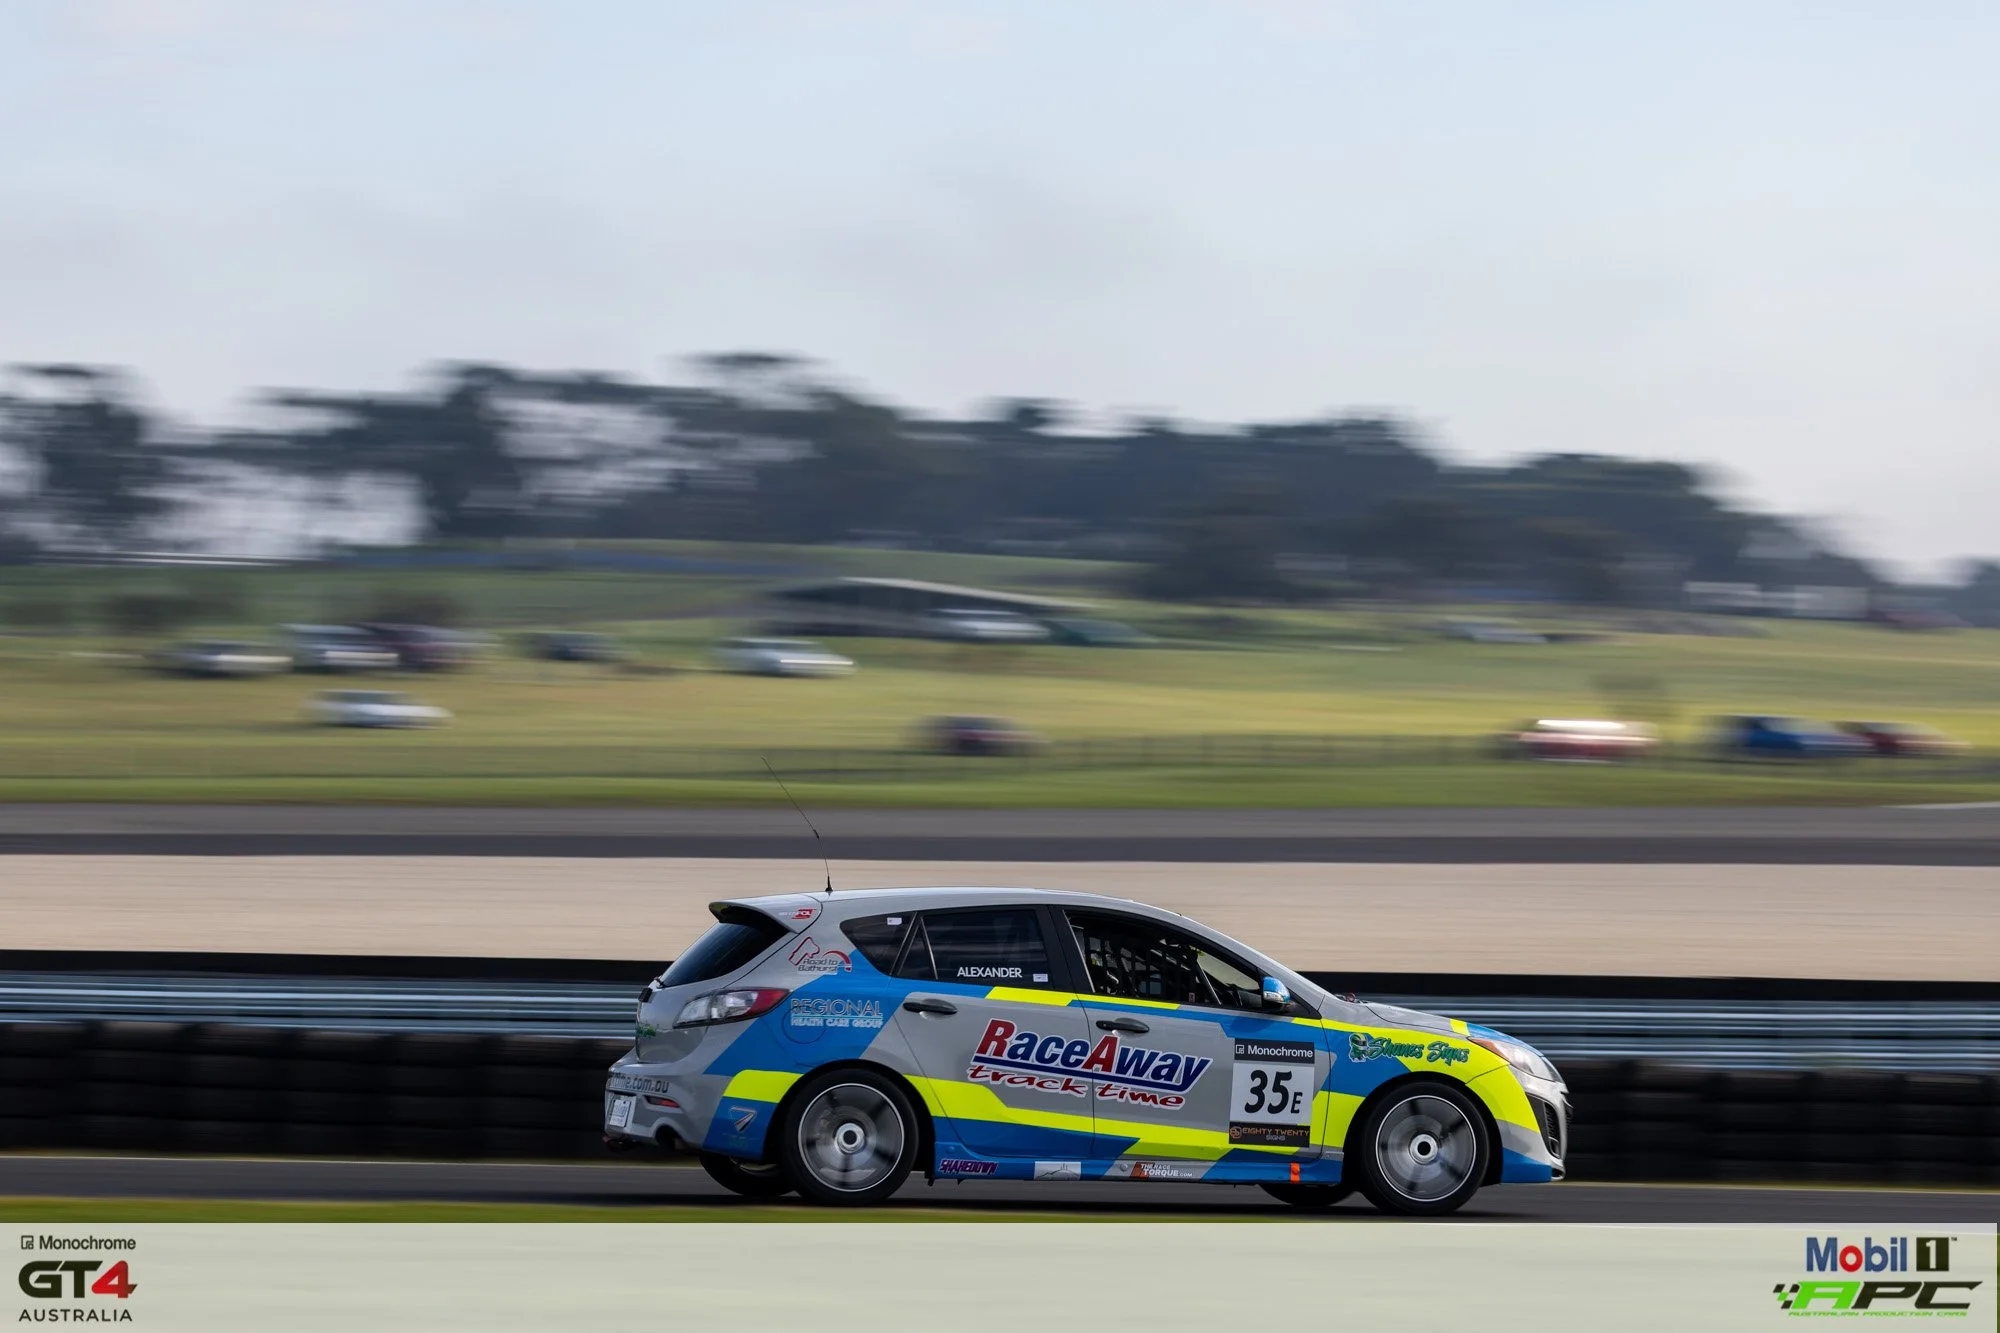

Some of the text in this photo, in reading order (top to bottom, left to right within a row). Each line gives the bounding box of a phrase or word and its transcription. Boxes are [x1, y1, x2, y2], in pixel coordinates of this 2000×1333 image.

[956, 966, 1023, 978] ALEXANDER
[790, 998, 883, 1016] REGIONAL
[974, 1018, 1212, 1092] RaceAway
[1247, 1044, 1314, 1058] Monochrome
[968, 1064, 1185, 1110] track time
[1242, 1127, 1309, 1137] EIGHTY TWENTY
